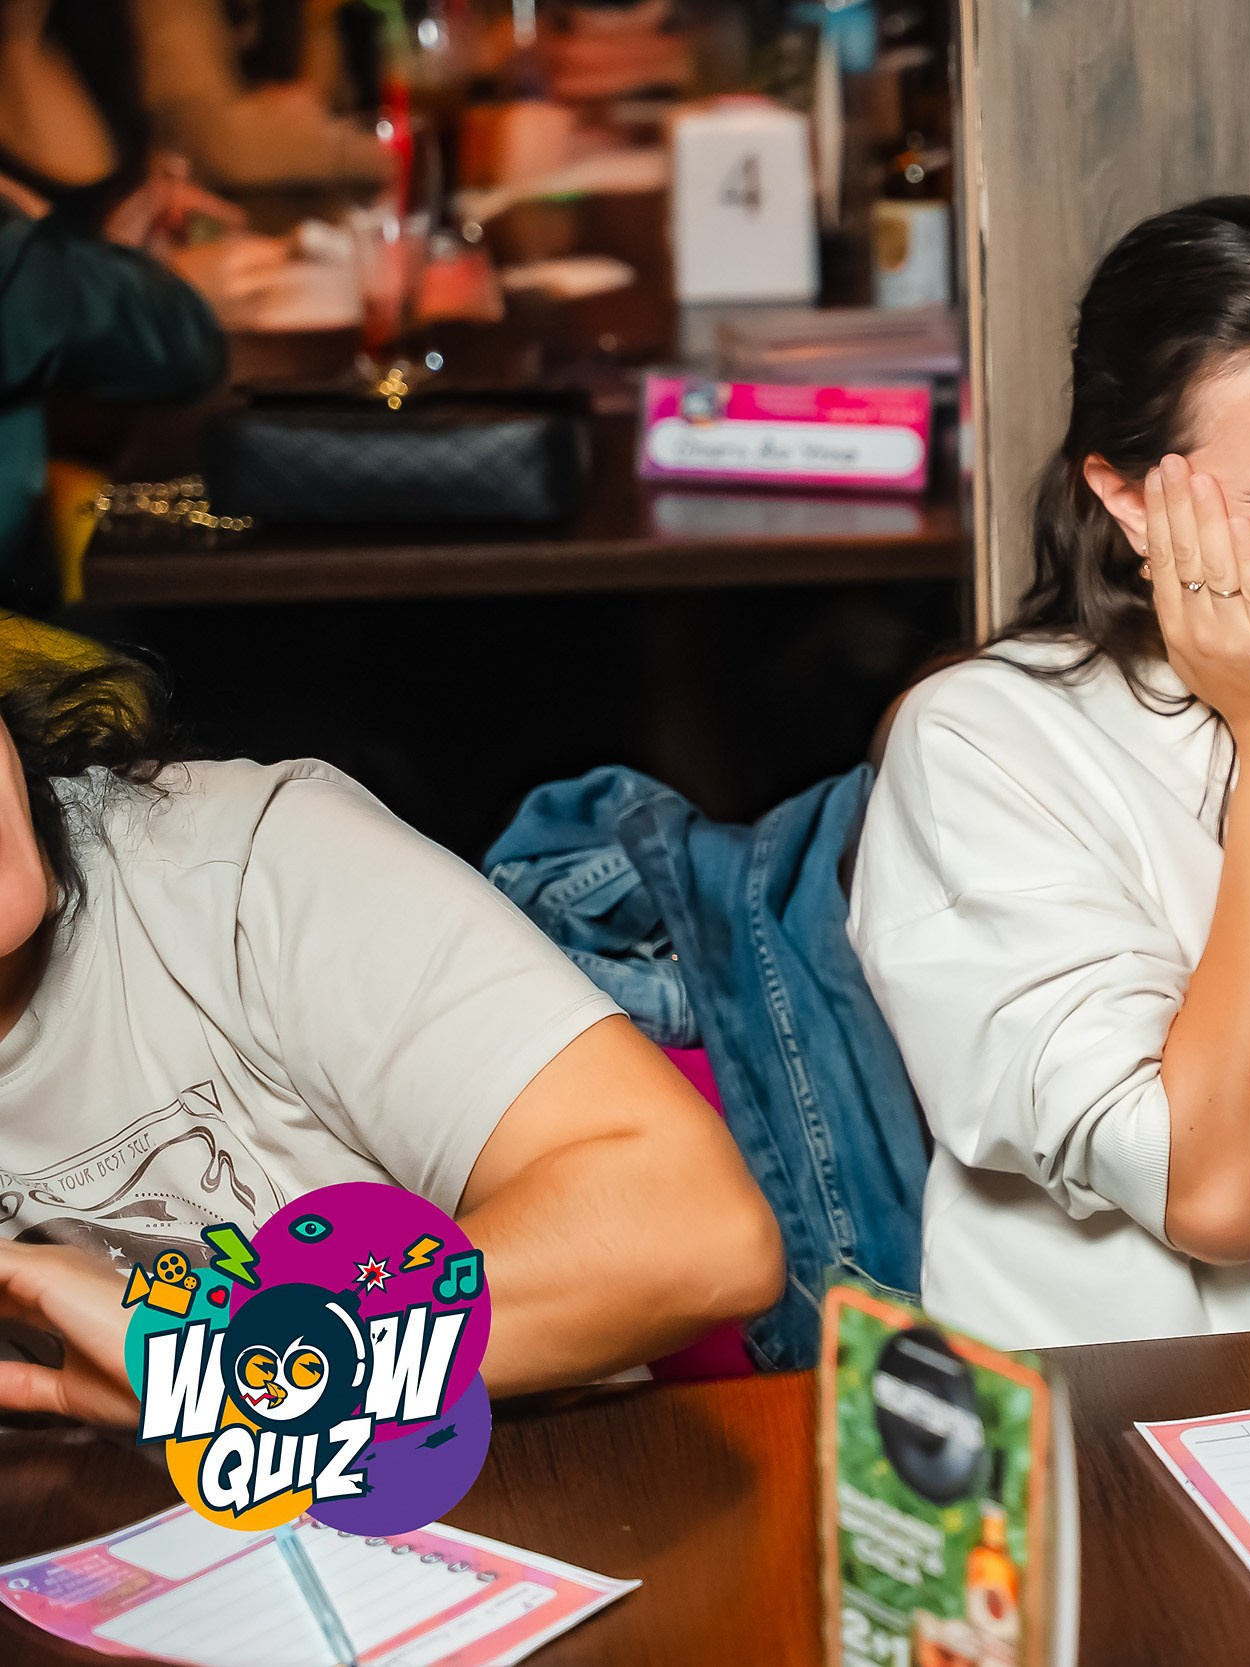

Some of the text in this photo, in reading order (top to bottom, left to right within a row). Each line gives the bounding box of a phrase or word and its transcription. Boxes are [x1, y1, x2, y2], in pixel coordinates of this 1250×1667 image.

[719, 151, 763, 219] 4
[58, 1167, 94, 1192] YOUR
[97, 1149, 126, 1177] BEST
